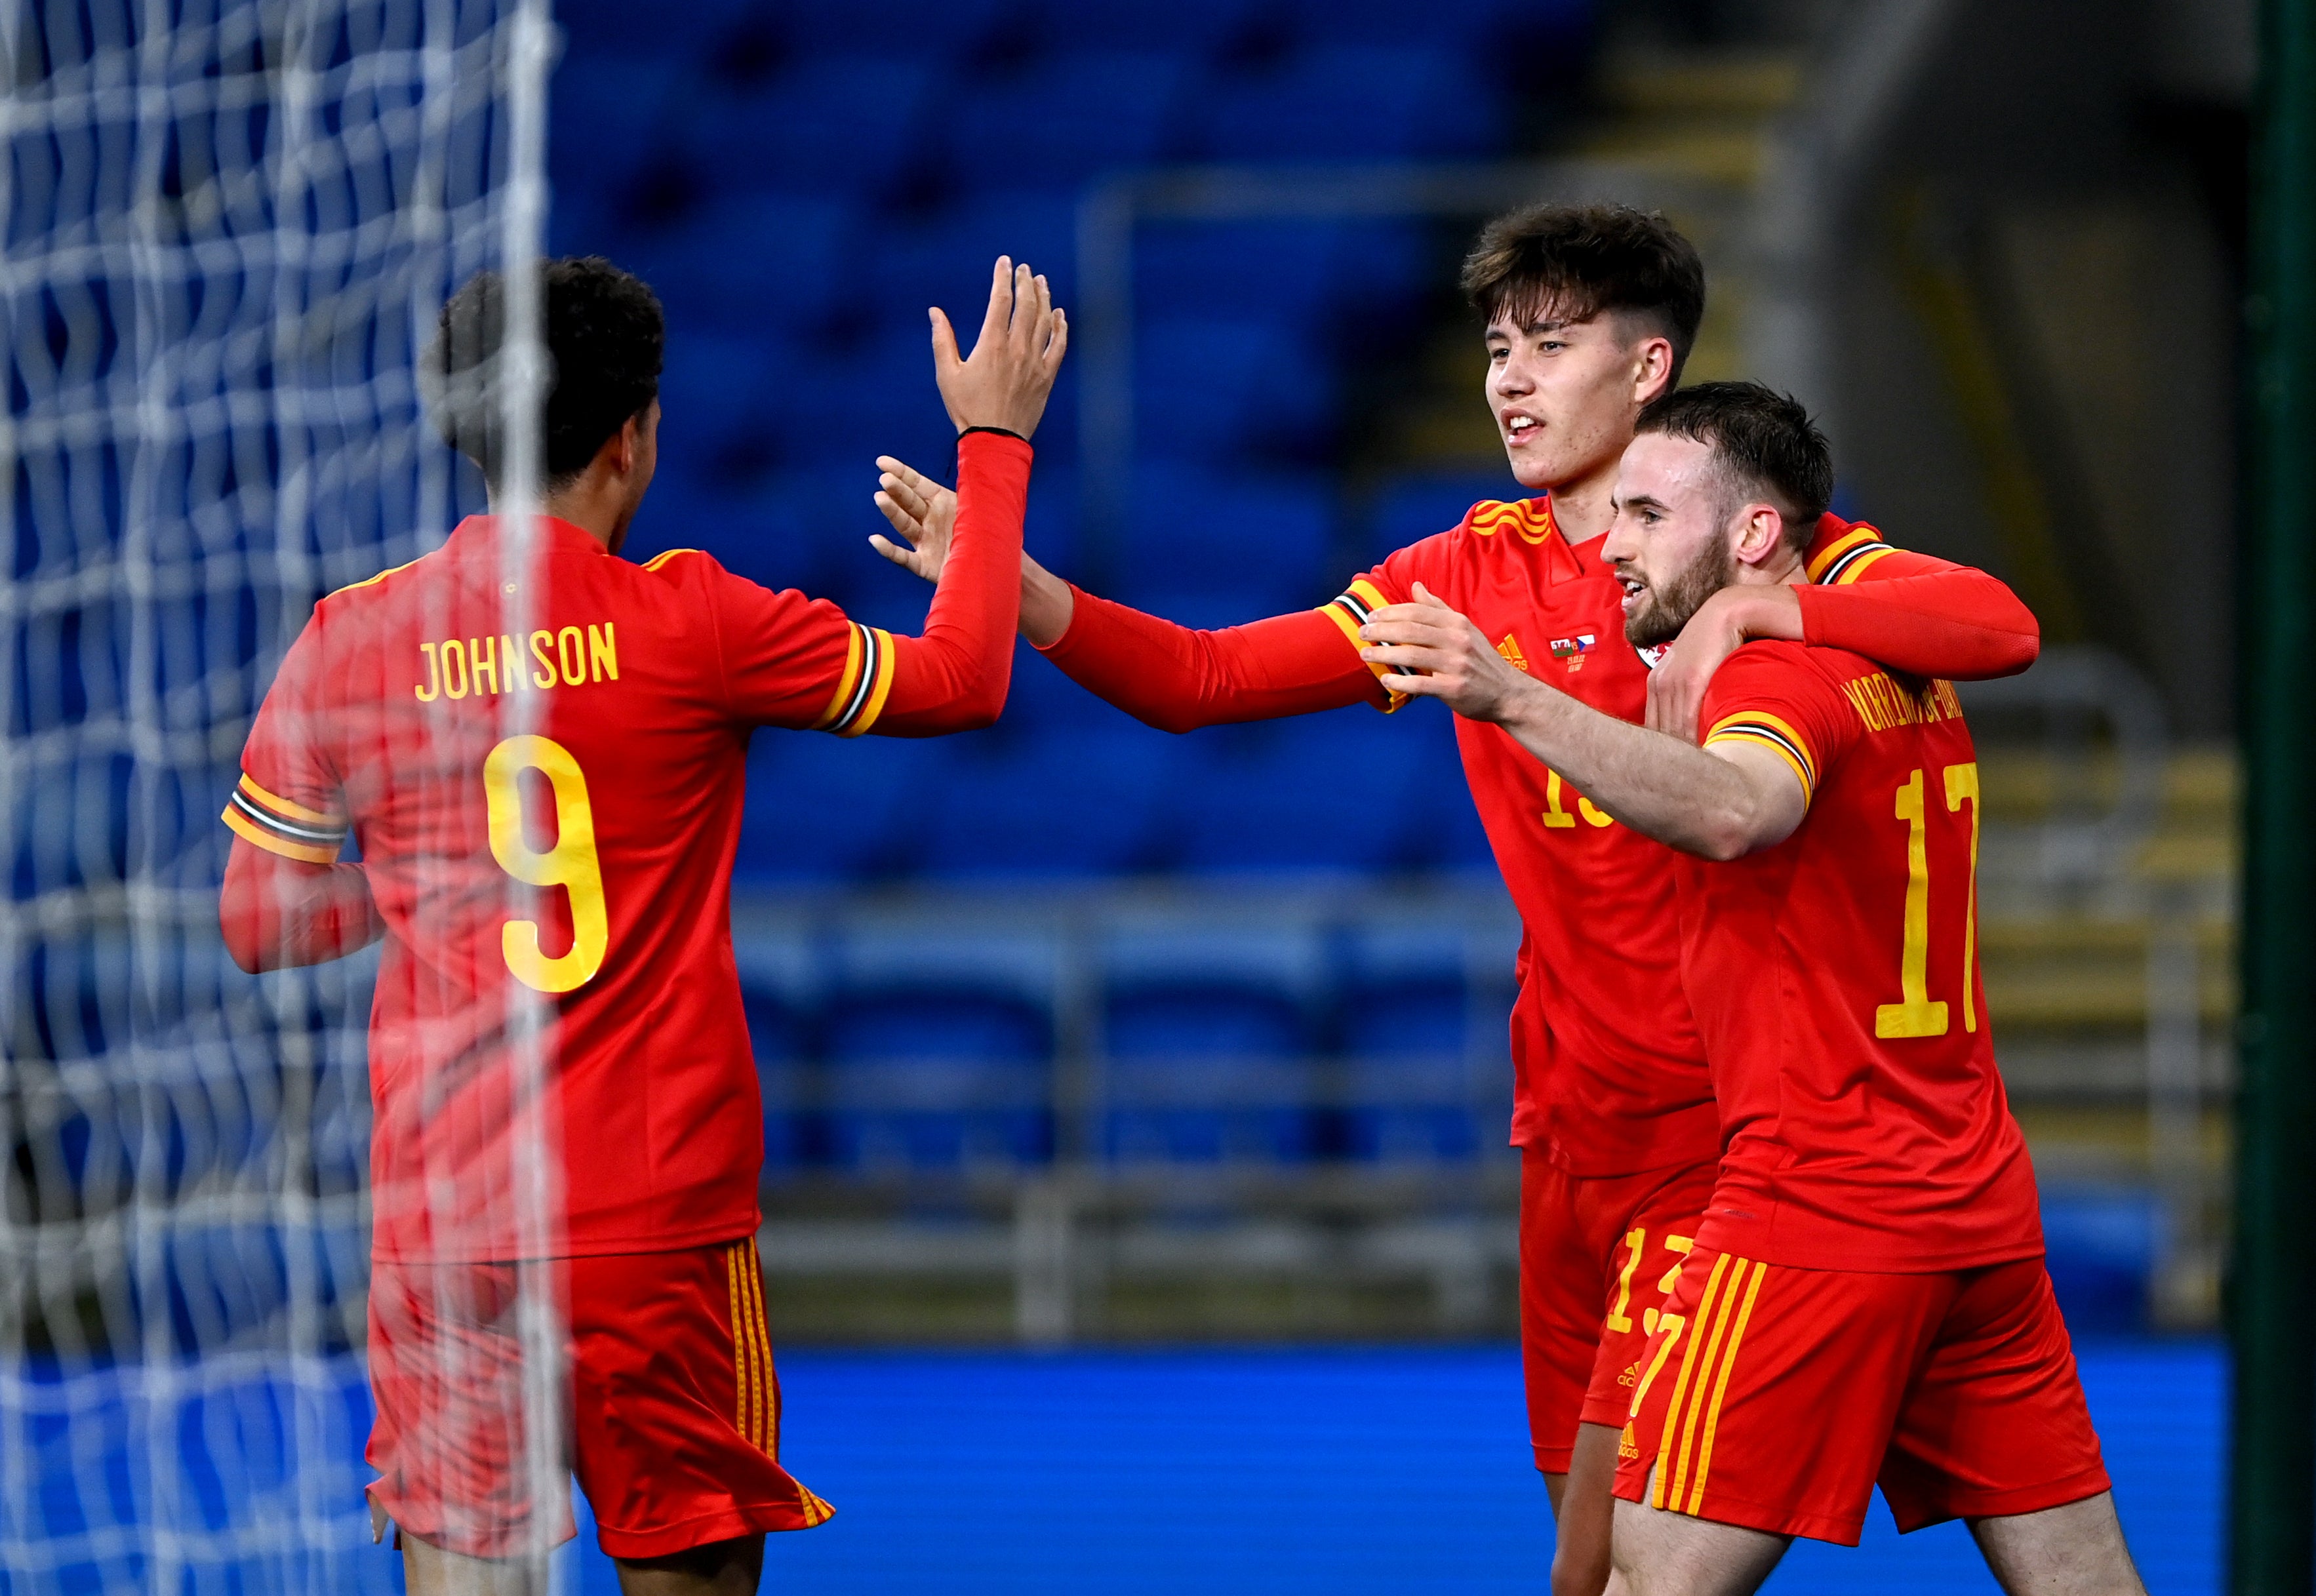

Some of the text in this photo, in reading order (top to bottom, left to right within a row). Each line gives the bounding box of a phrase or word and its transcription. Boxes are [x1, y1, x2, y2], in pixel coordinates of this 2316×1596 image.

[414, 622, 619, 702] JOHNSON
[483, 734, 608, 993] 9
[1875, 762, 1979, 1039] 17
